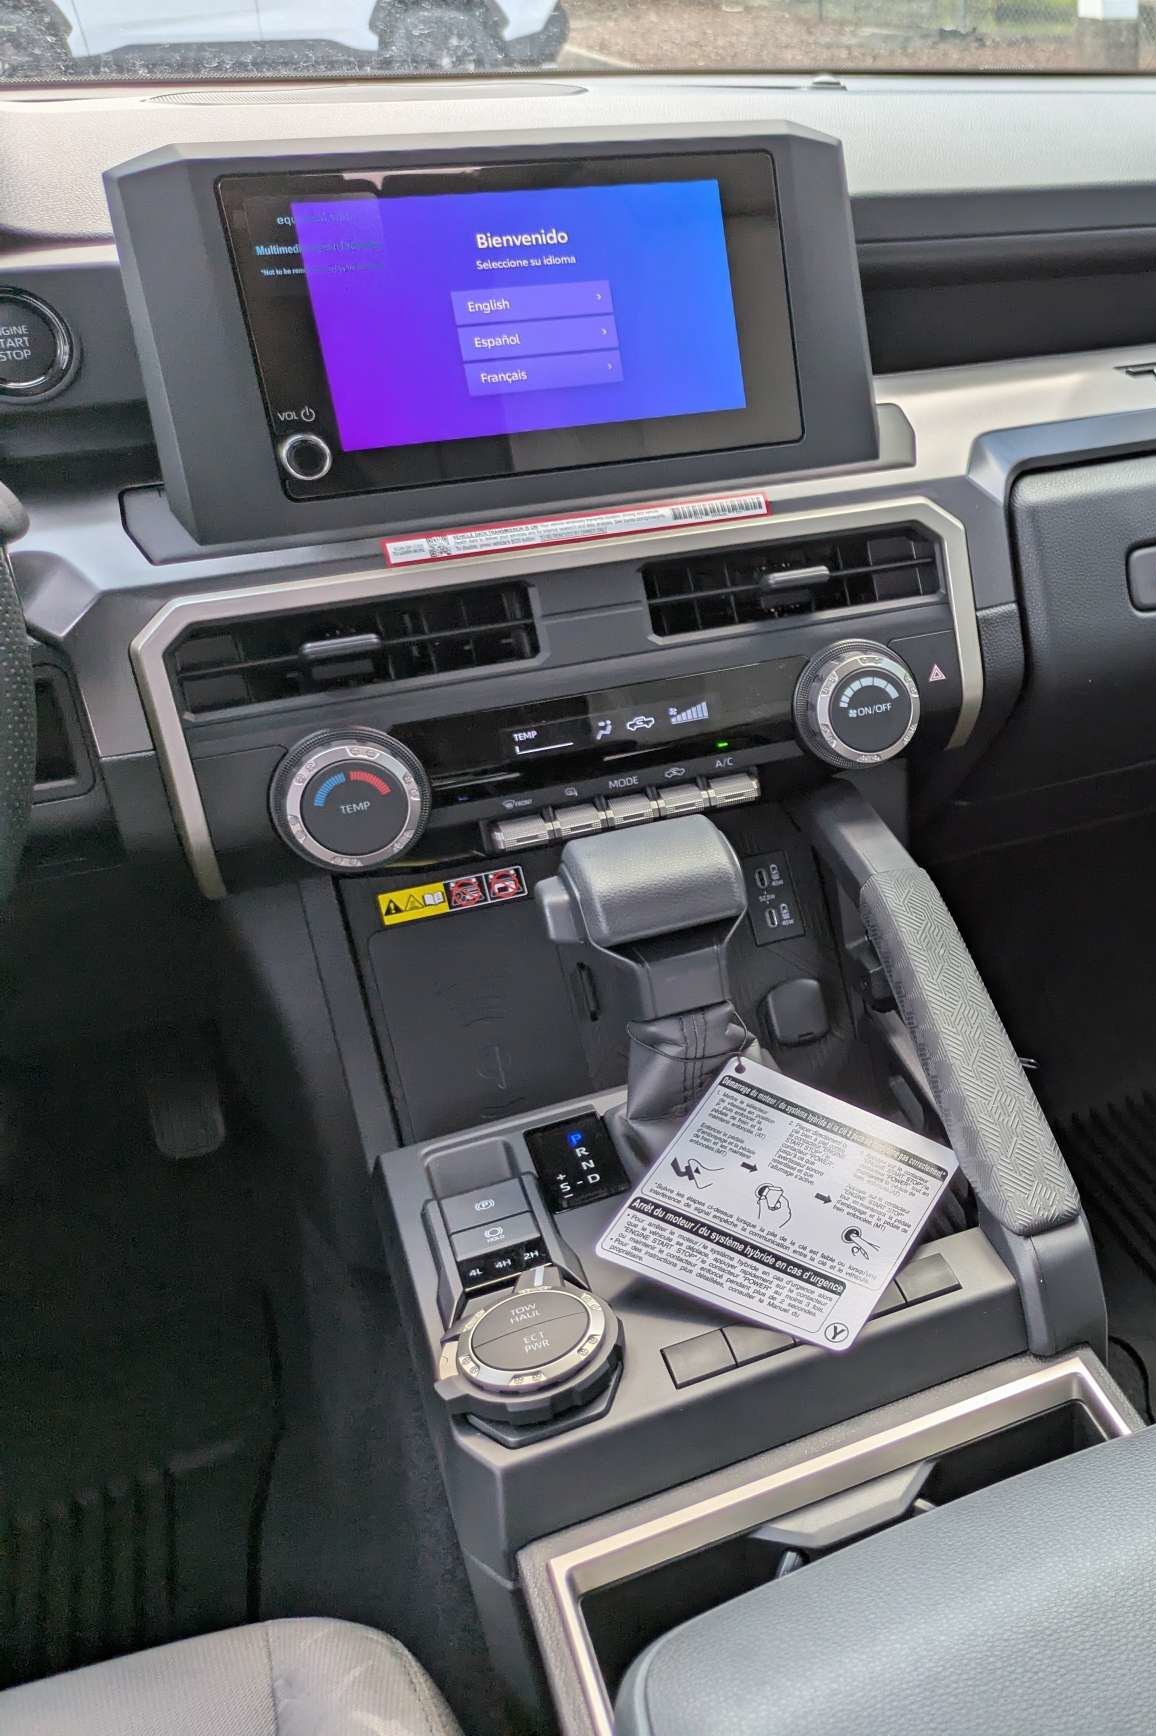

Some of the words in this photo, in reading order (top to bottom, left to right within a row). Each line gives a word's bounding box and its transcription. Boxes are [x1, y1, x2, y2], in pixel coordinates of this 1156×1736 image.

[476, 229, 569, 249] Bienvenido
[476, 258, 529, 271] Seleccione
[530, 258, 542, 267] su
[543, 255, 576, 267] idioma
[467, 299, 510, 314] English
[474, 333, 521, 349] Español
[480, 370, 528, 384] Français
[277, 411, 299, 421] VOL
[857, 703, 893, 717] ON/OFF
[513, 731, 538, 742] TEMP
[715, 757, 734, 769] A/C
[608, 776, 639, 789] MODE
[340, 801, 371, 815] TEMP
[568, 1133, 582, 1145] P
[576, 1147, 589, 1158] R
[582, 1160, 595, 1170] N
[587, 1174, 600, 1184] D
[560, 1182, 571, 1192] S
[631, 1197, 655, 1213] Arrêt
[651, 1206, 667, 1219] du
[663, 1211, 695, 1230] moteur
[696, 1225, 711, 1237] du
[708, 1230, 745, 1252] système
[742, 1245, 777, 1265] hybride
[774, 1258, 788, 1270] en
[785, 1263, 804, 1277] cas
[801, 1270, 844, 1294] d'urgence
[650, 1237, 672, 1250] START
[469, 1268, 483, 1277] 4L
[495, 1259, 512, 1268] 4H
[524, 1250, 539, 1260] 2H
[511, 1303, 537, 1316] TOW
[510, 1310, 541, 1324] HAUL
[523, 1331, 545, 1343] ECT
[827, 1325, 845, 1341] Y
[524, 1339, 550, 1352] PWR
